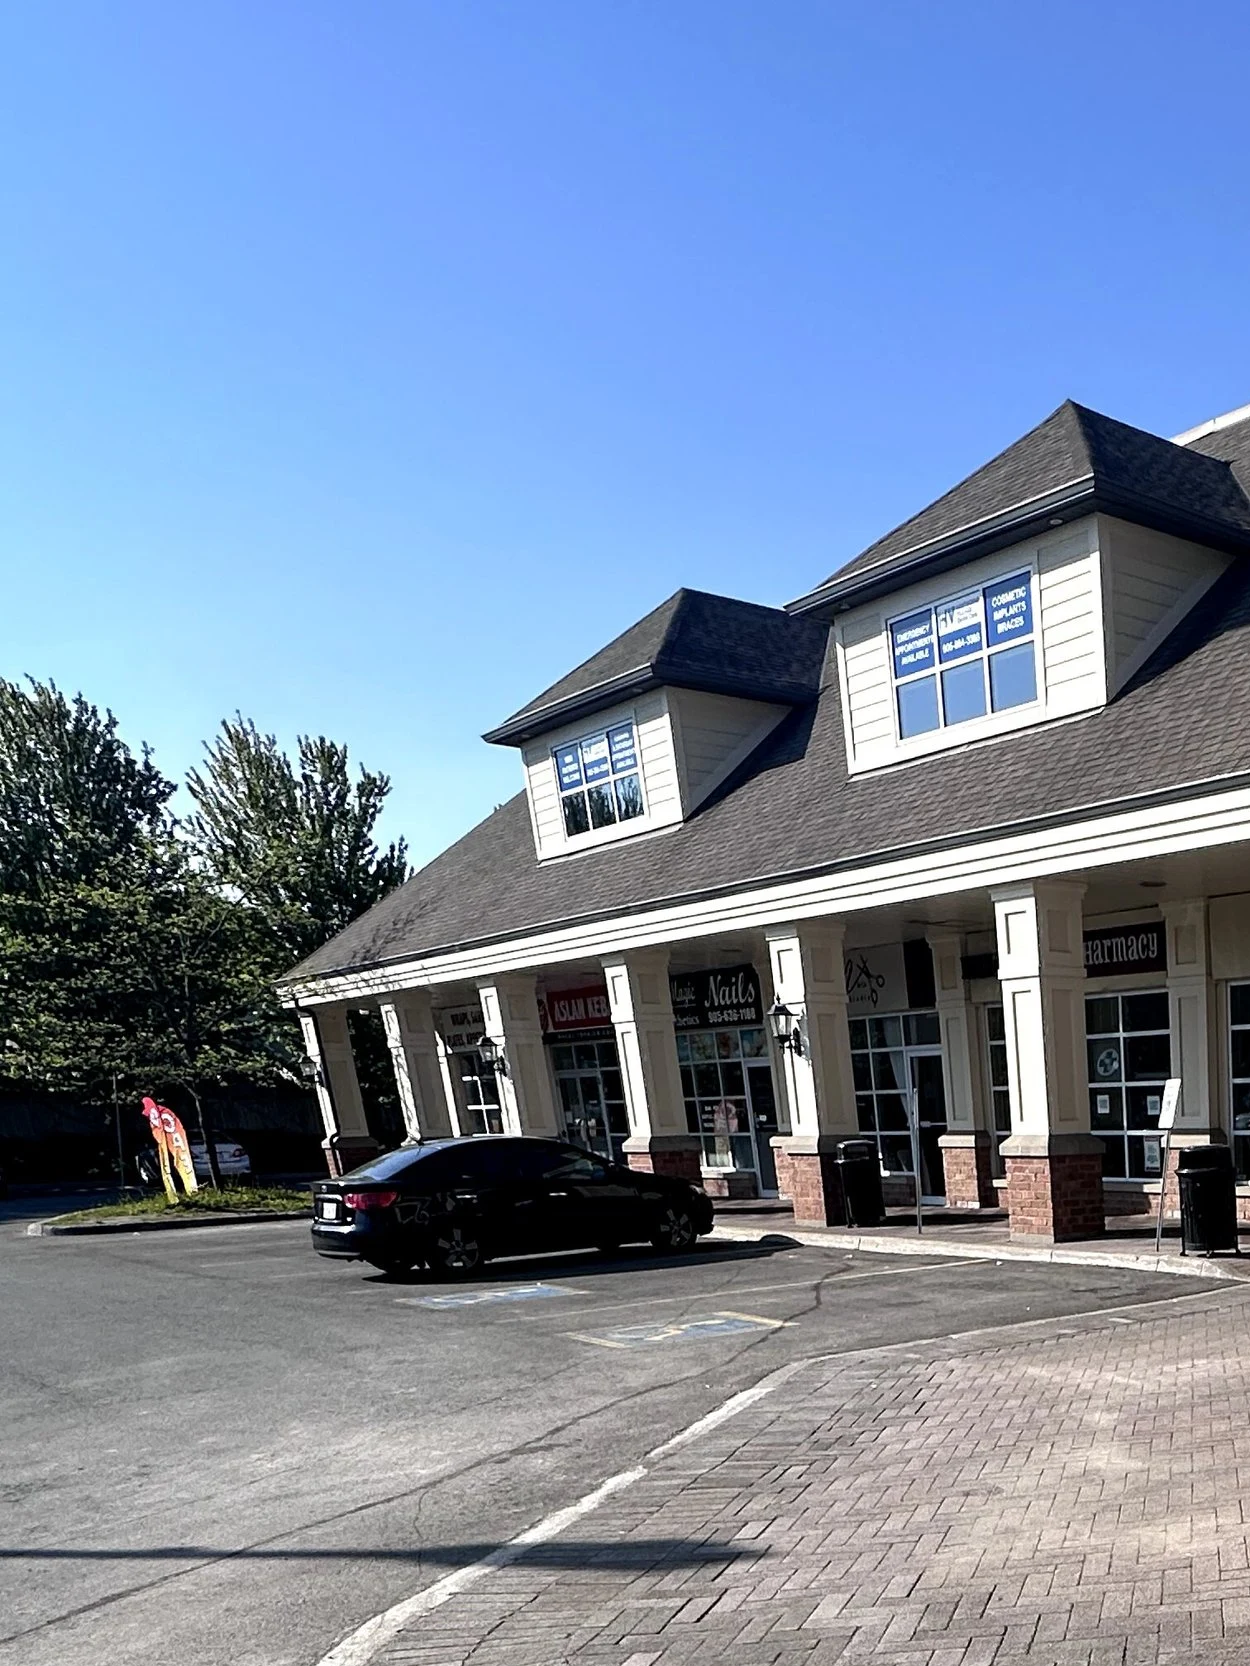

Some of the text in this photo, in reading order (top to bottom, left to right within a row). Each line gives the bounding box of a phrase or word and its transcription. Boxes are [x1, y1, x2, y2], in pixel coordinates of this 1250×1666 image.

[992, 586, 1026, 607] COSMETIC
[993, 601, 1026, 621] IMPLANTS
[704, 971, 755, 1008] Nails
